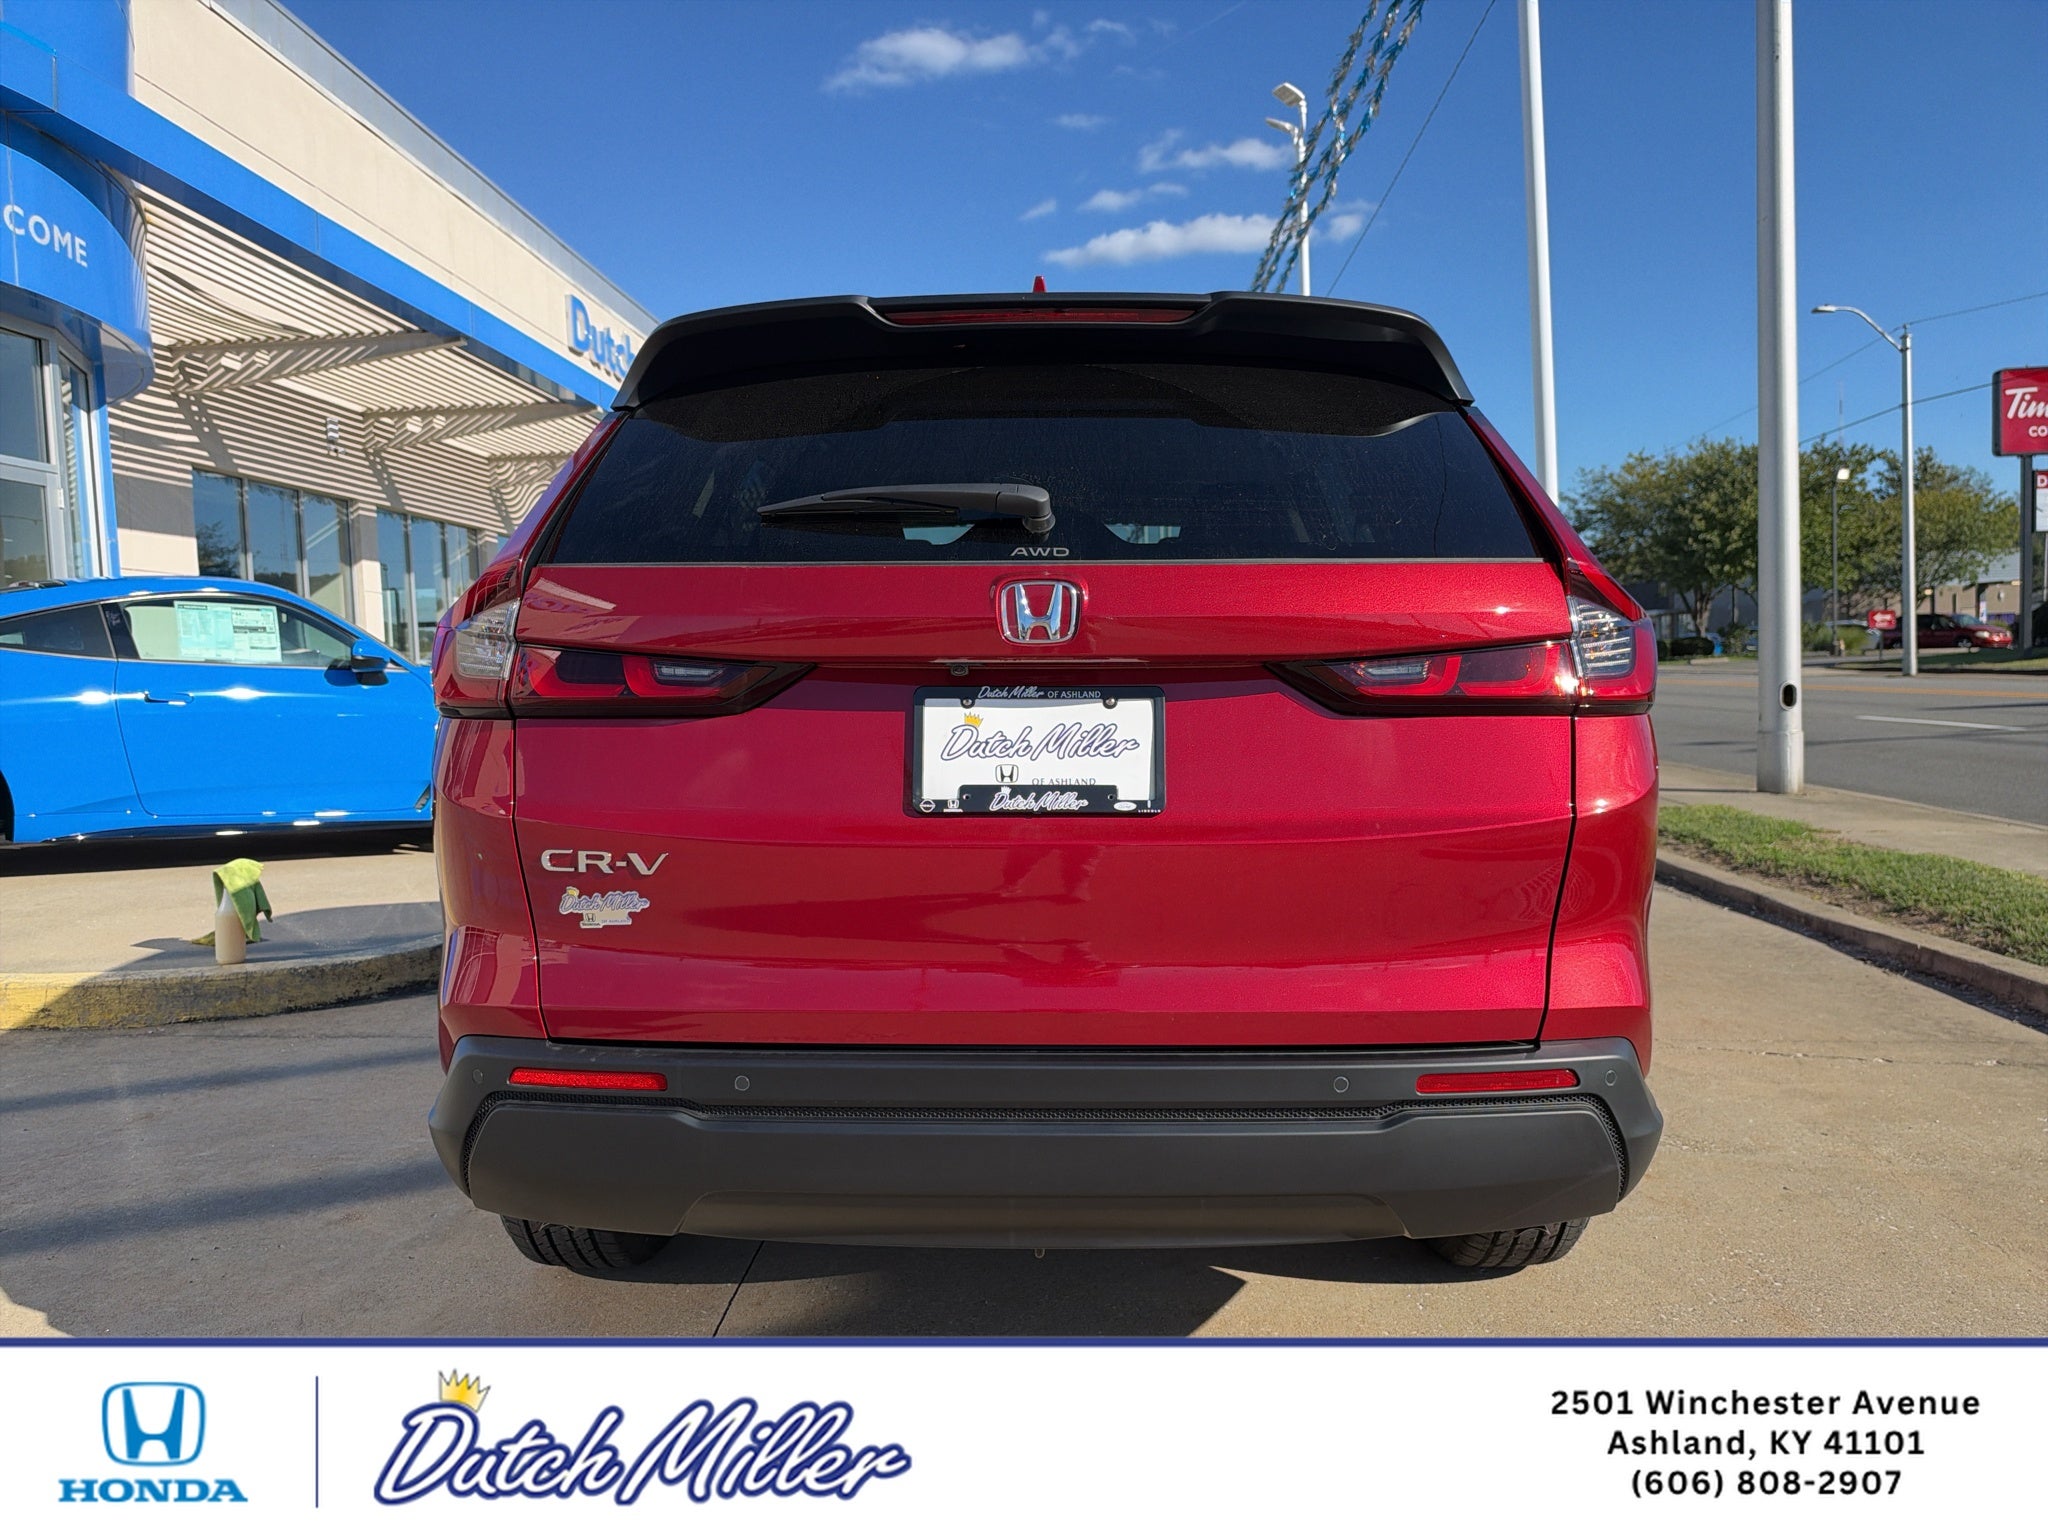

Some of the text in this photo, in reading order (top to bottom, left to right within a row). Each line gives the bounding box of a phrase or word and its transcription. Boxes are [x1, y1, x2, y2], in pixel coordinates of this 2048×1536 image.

[3, 204, 88, 269] COME
[1010, 547, 1070, 557] AWD
[978, 685, 1102, 699] Dutch Miller OF ASHLAND
[941, 722, 1141, 761] Dutch Miller
[1048, 777, 1096, 785] ASHLAND
[989, 791, 1089, 811] Dutch Miller
[541, 849, 669, 876] CR-V
[560, 891, 649, 912] Dutch Miller
